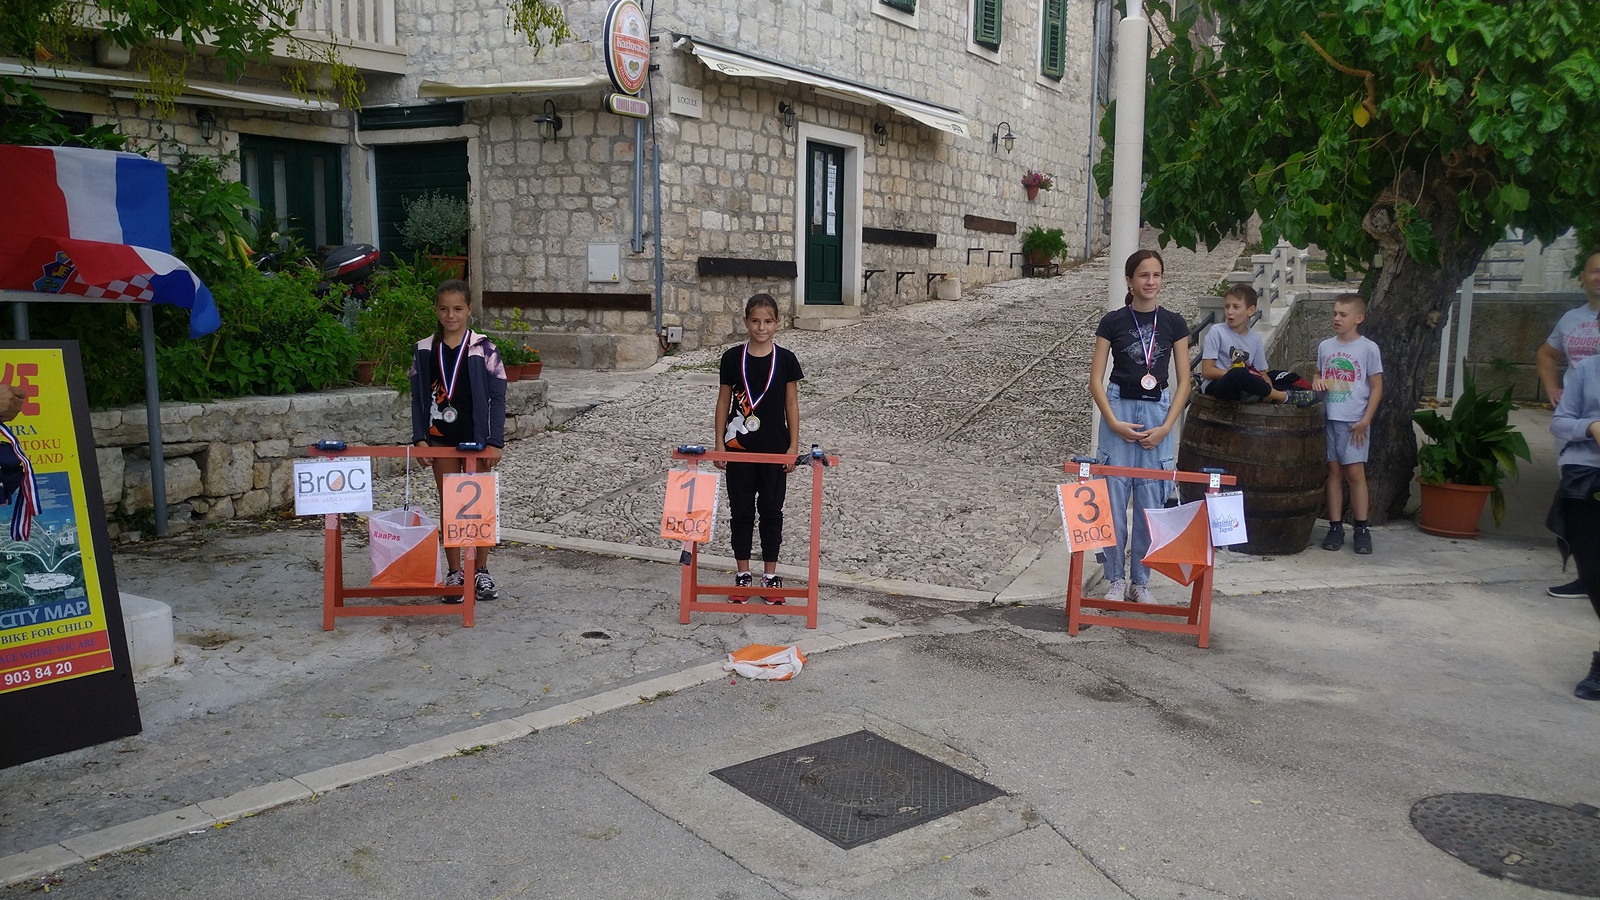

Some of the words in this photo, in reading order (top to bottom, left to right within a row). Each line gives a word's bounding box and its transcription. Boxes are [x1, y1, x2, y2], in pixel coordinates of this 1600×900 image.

[1568, 336, 1599, 347] ROUGH
[298, 468, 366, 494] BrOC
[455, 480, 482, 520] 2
[680, 477, 696, 514] 1
[1074, 486, 1100, 524] 3
[373, 530, 401, 541] KanPas
[447, 523, 491, 539] BrOC
[665, 516, 707, 534] BrOC
[1073, 524, 1112, 544] BrOC
[0, 608, 40, 629] CITY
[44, 601, 88, 620] MAP
[1, 632, 29, 645] BIKE
[31, 627, 55, 639] FOR
[56, 620, 93, 634] CHILD
[20, 646, 54, 660] WHERE
[56, 643, 76, 654] YOU
[78, 639, 96, 649] ARE
[4, 670, 31, 685] 903
[35, 665, 52, 679] 84
[55, 661, 73, 675] 20
